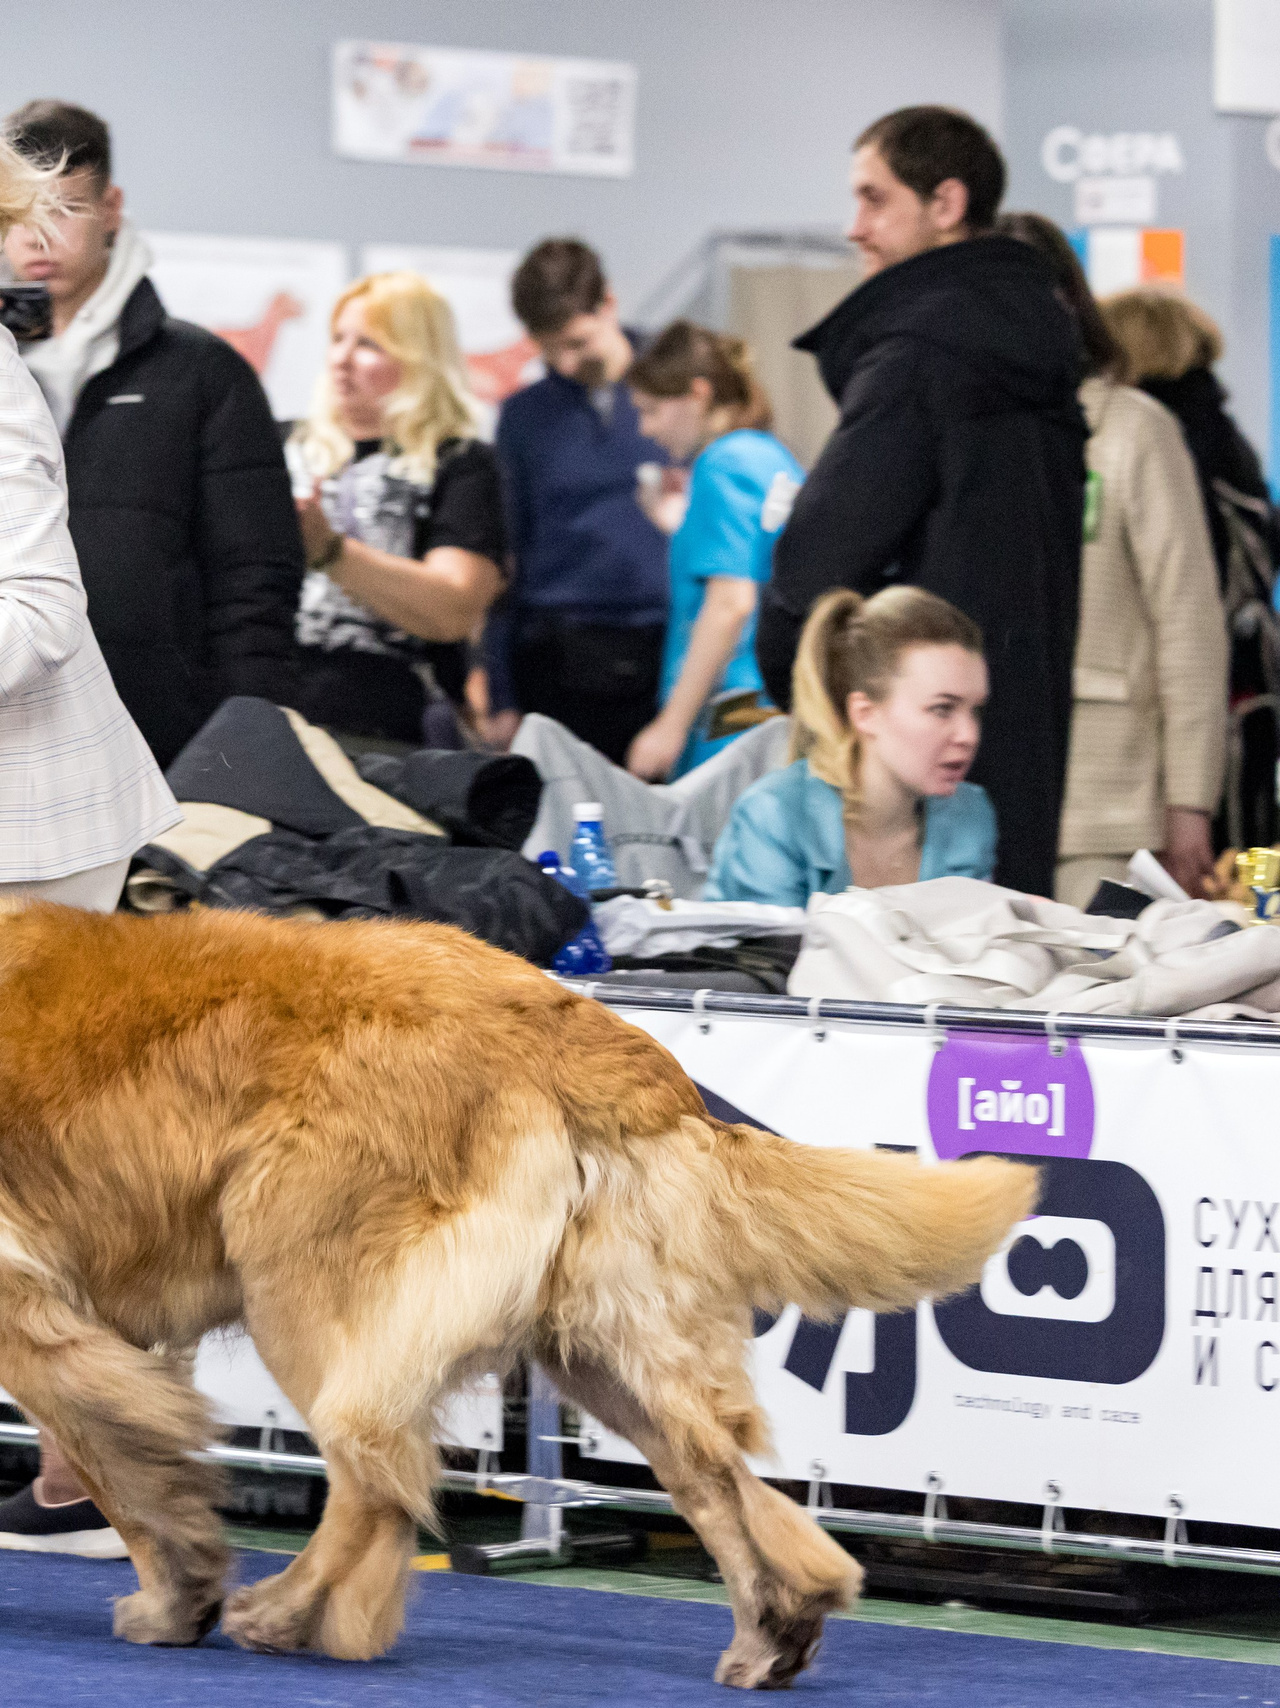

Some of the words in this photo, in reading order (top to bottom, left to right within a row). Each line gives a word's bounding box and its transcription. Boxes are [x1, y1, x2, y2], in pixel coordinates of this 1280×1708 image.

[1190, 1265, 1280, 1329] ДЛЯ
[1193, 1333, 1220, 1388] И
[1061, 1404, 1093, 1420] and
